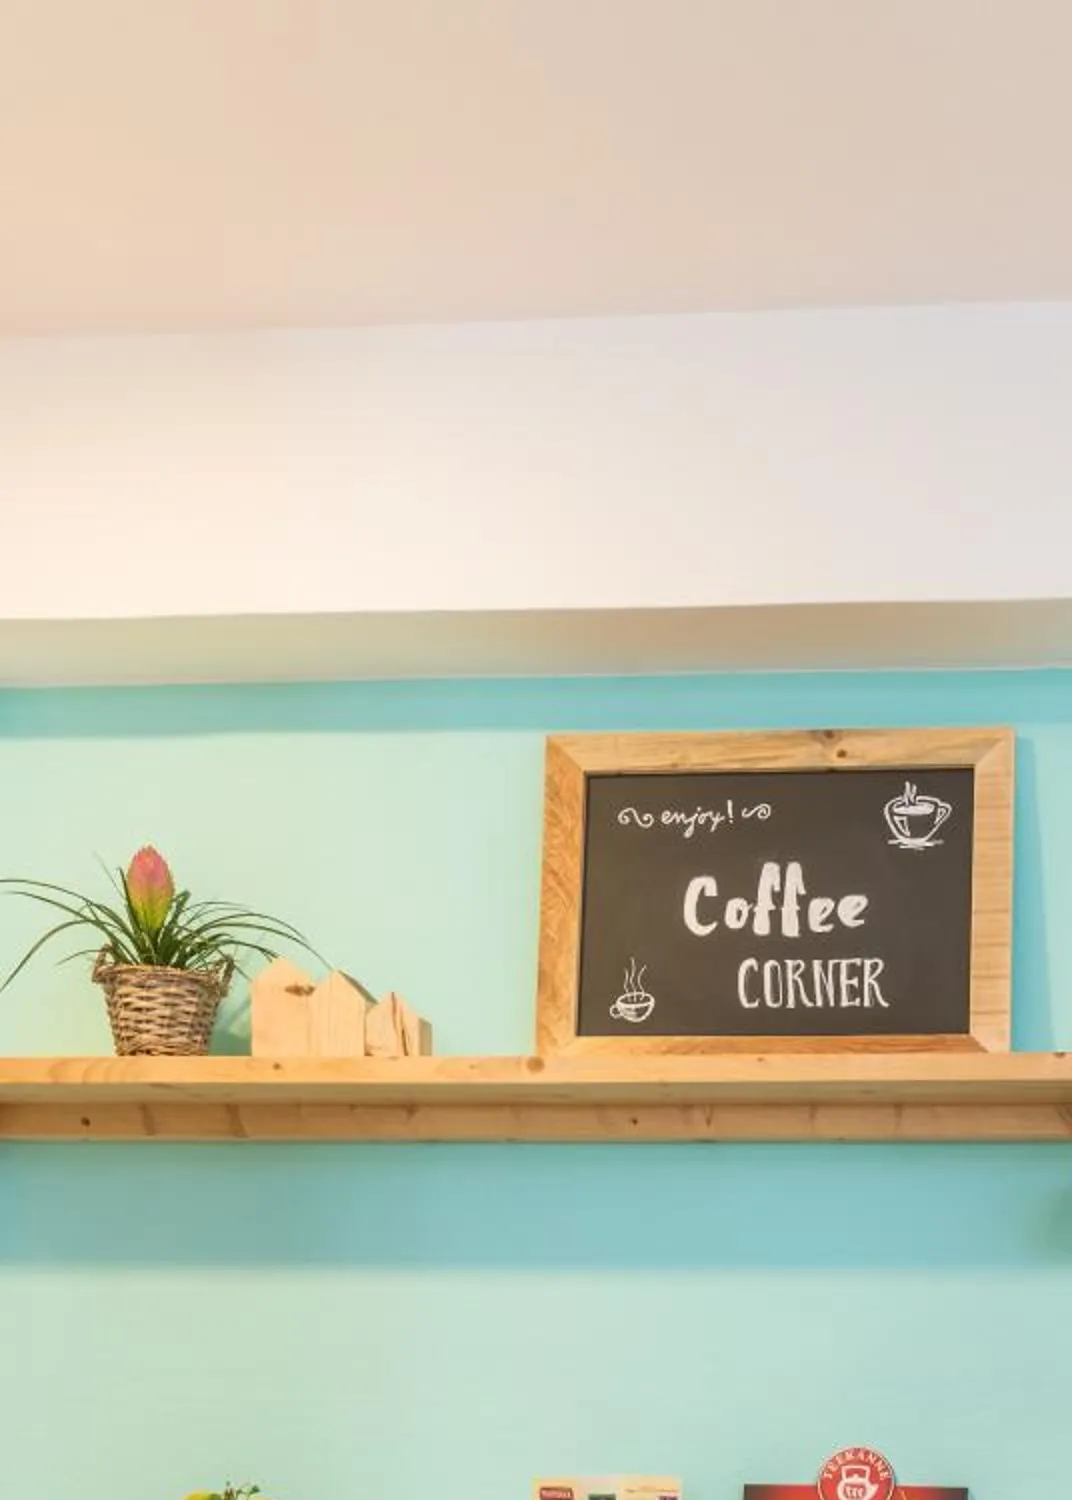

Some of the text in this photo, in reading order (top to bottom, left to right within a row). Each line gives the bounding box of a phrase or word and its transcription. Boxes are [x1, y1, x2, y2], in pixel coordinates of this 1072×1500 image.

[660, 799, 735, 839] enjoy!
[682, 861, 870, 938] Coffee
[736, 957, 890, 1010] CORNER
[822, 1446, 891, 1481] TEEKANNE
